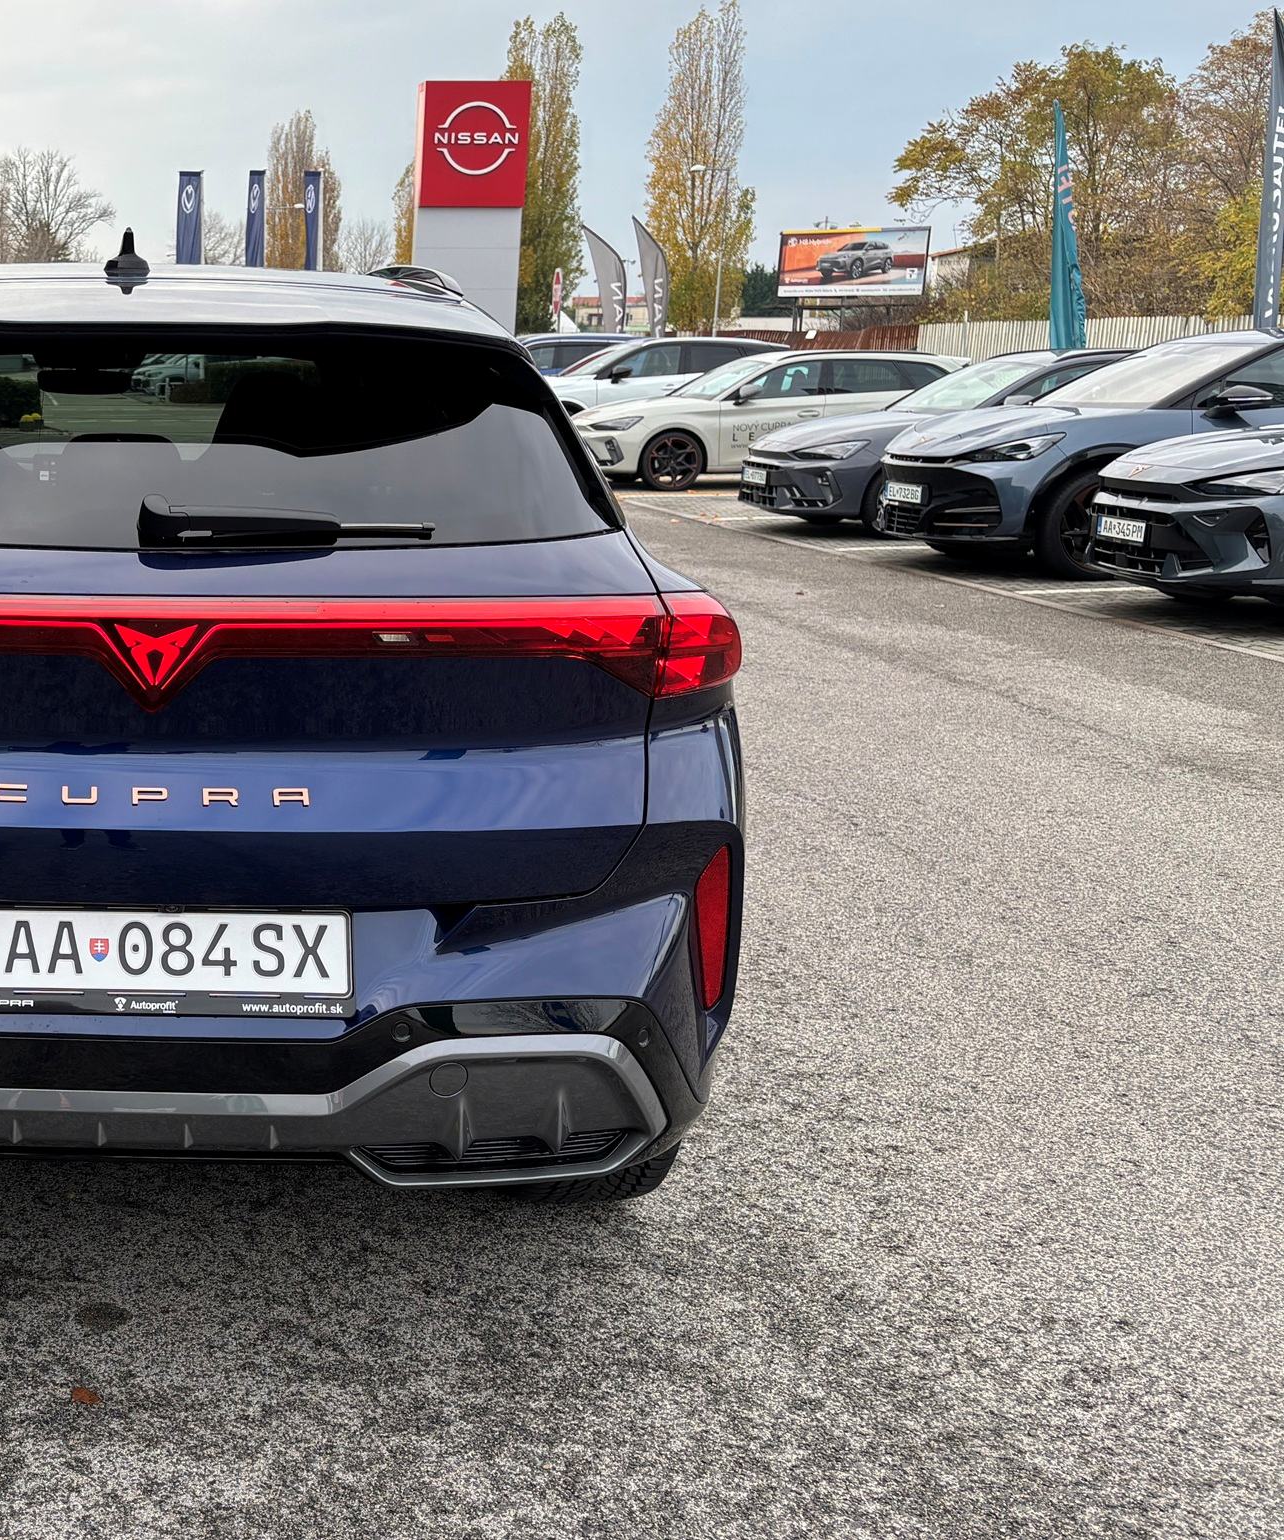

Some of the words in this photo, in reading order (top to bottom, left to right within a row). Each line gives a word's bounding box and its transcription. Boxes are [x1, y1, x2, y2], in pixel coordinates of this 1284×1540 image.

[433, 132, 519, 145] NISSAN
[1103, 519, 1113, 534] AA
[1116, 521, 1143, 539] 345PM
[4, 920, 83, 974] AA
[118, 921, 330, 978] 084SX
[130, 1000, 176, 1011] Autoprofit
[241, 1003, 344, 1015] www.autoprofit.sk
